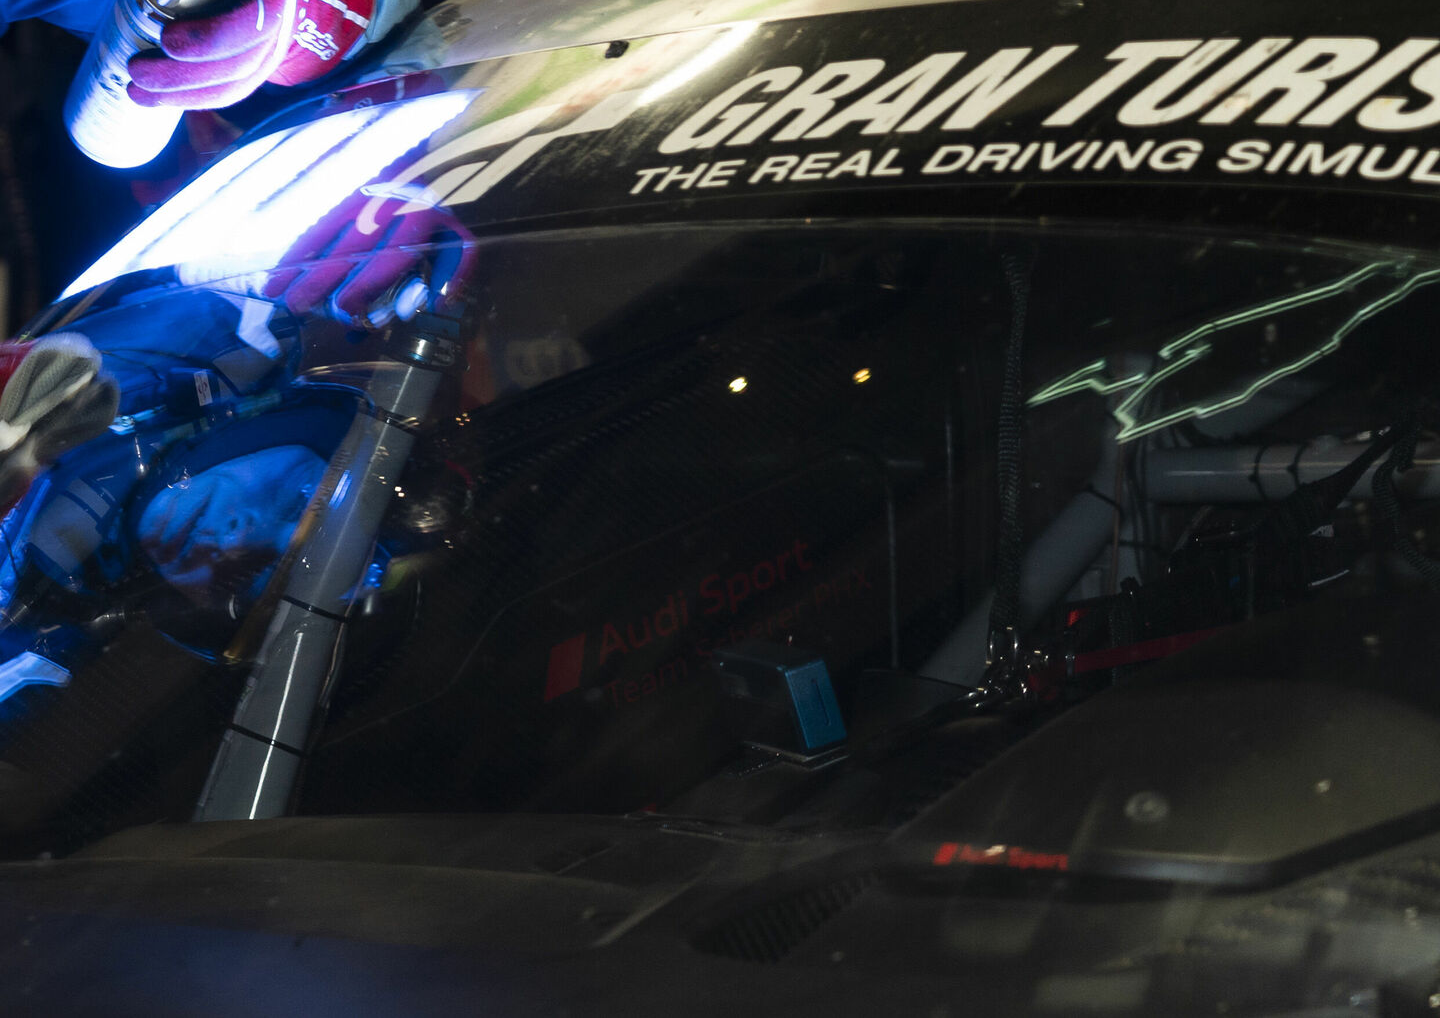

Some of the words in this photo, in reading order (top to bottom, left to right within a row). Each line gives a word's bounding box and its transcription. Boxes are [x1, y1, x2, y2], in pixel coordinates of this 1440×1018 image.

[657, 44, 1080, 155] GRAN
[628, 158, 747, 195] THE
[747, 147, 905, 185] REAL
[919, 137, 1205, 175] DRIVING
[599, 589, 690, 667] Audi
[699, 537, 813, 616] Sport
[605, 655, 689, 710] Team
